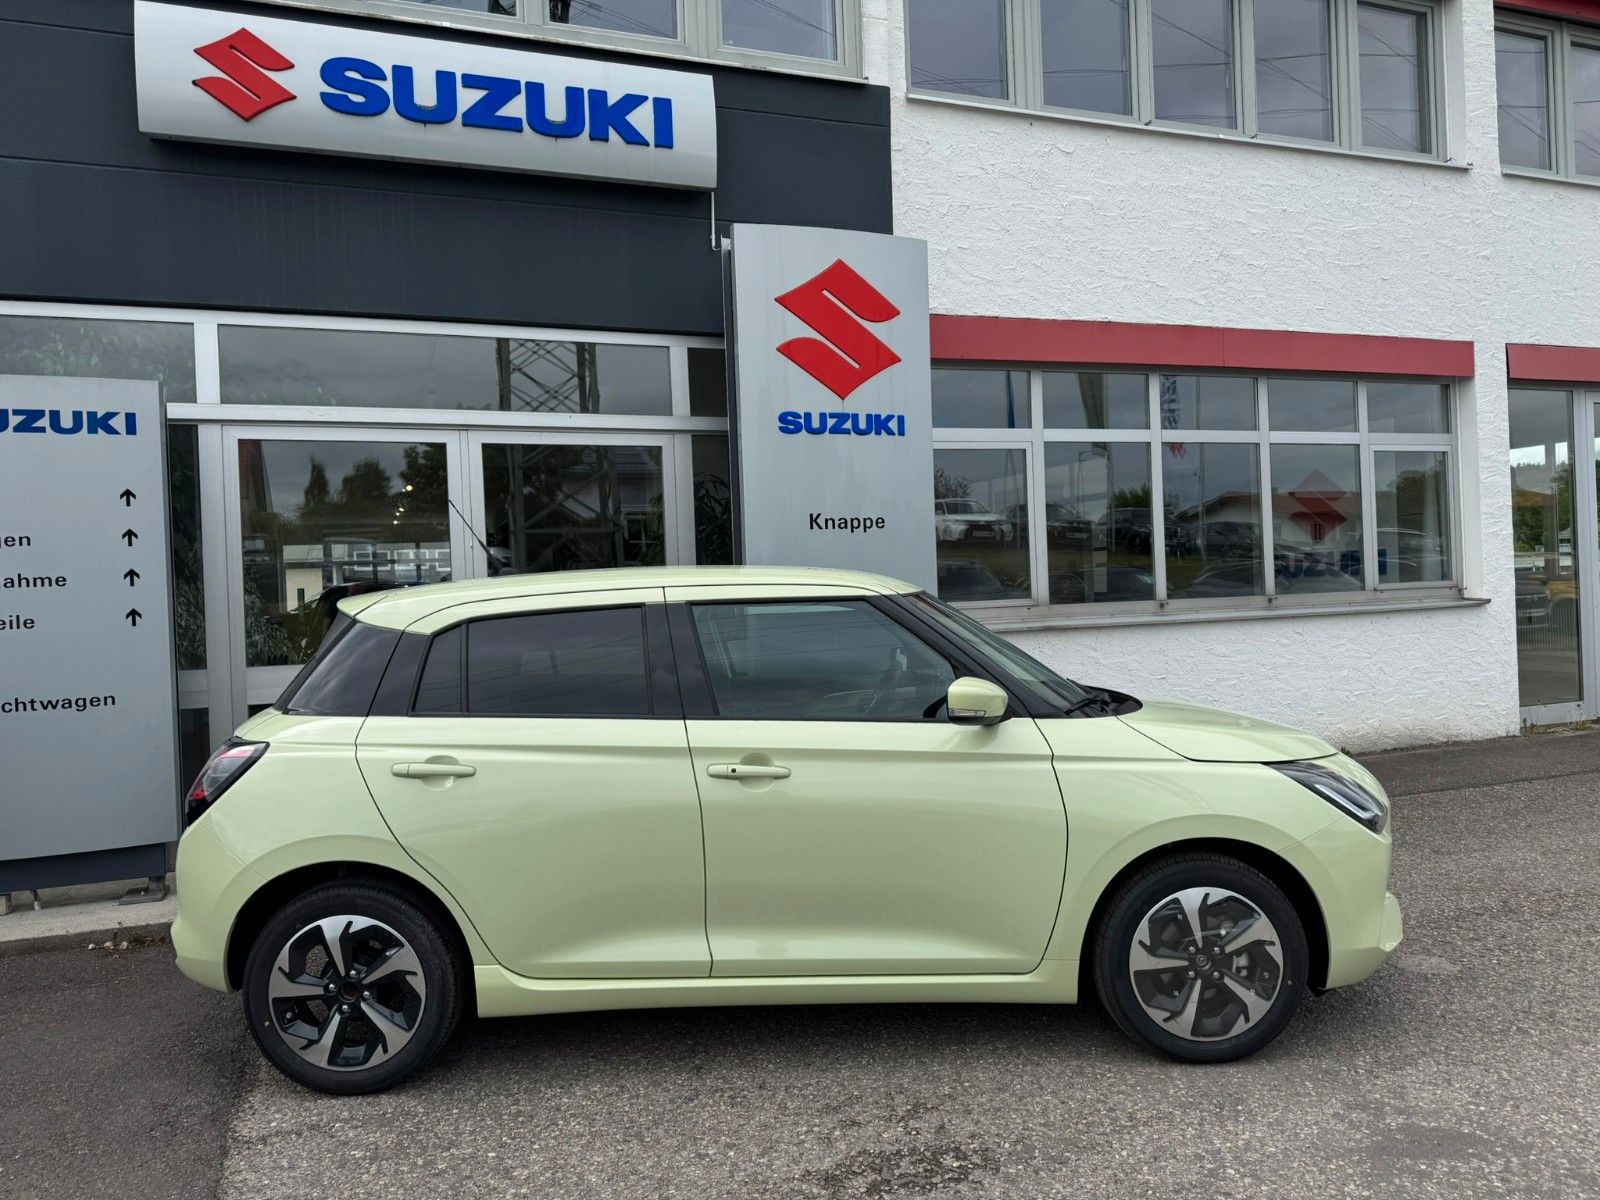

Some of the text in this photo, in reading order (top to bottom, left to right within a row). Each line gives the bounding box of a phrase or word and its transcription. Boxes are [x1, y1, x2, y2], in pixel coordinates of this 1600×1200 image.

[319, 56, 674, 149] SUZUKI
[0, 408, 138, 436] ZUKI
[777, 411, 906, 437] SUZUKI
[809, 512, 886, 533] Knappe
[0, 535, 31, 549] en
[1, 695, 116, 714] chtwagen
